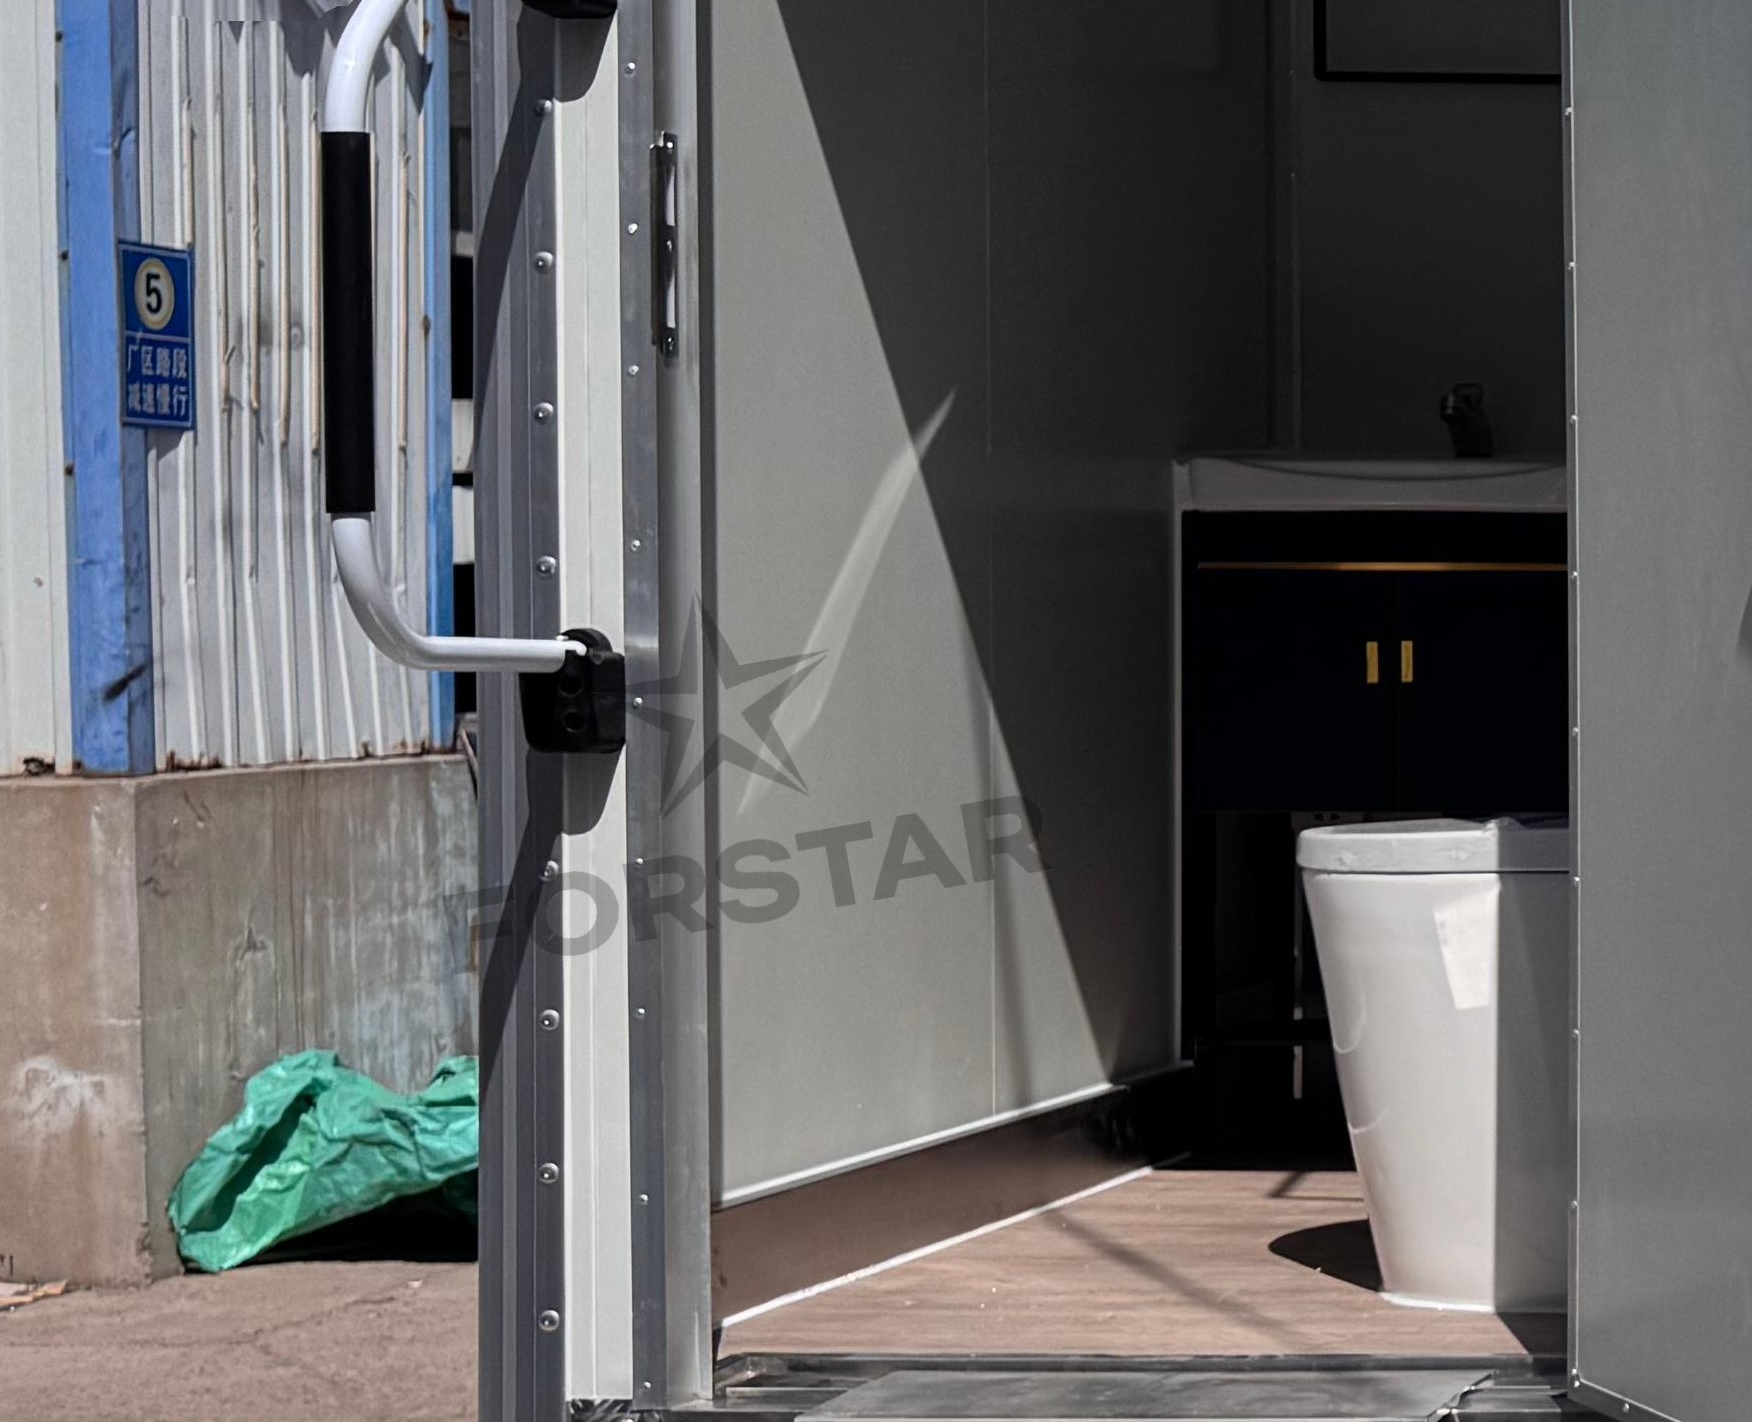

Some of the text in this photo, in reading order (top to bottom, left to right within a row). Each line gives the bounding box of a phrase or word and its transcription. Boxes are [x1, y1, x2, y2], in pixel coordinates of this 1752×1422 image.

[146, 272, 162, 314] 5
[127, 343, 187, 378] 厂区路段
[128, 381, 187, 417] 减速慢行
